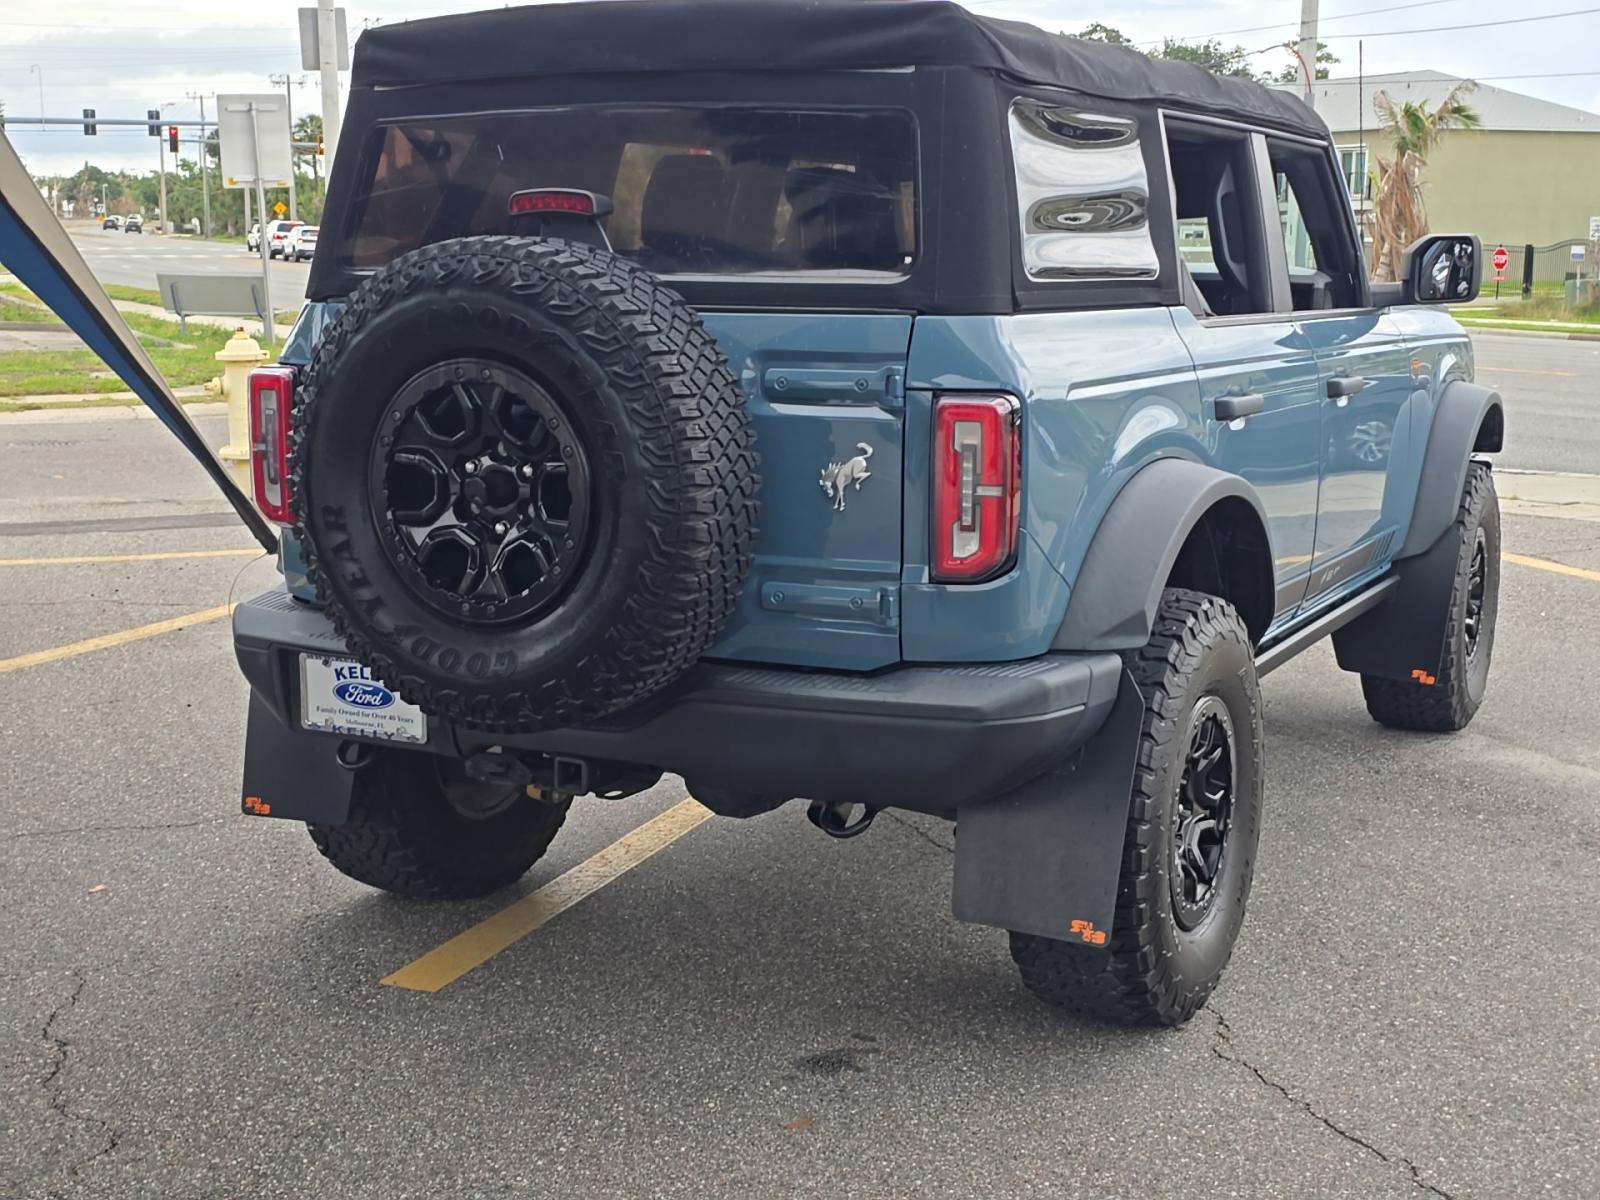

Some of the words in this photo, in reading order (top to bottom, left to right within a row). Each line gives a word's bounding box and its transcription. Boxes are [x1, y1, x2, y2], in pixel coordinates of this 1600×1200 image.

[334, 664, 377, 681] KEL
[345, 684, 383, 706] Ford
[338, 708, 360, 717] Owned
[371, 712, 387, 720] Over
